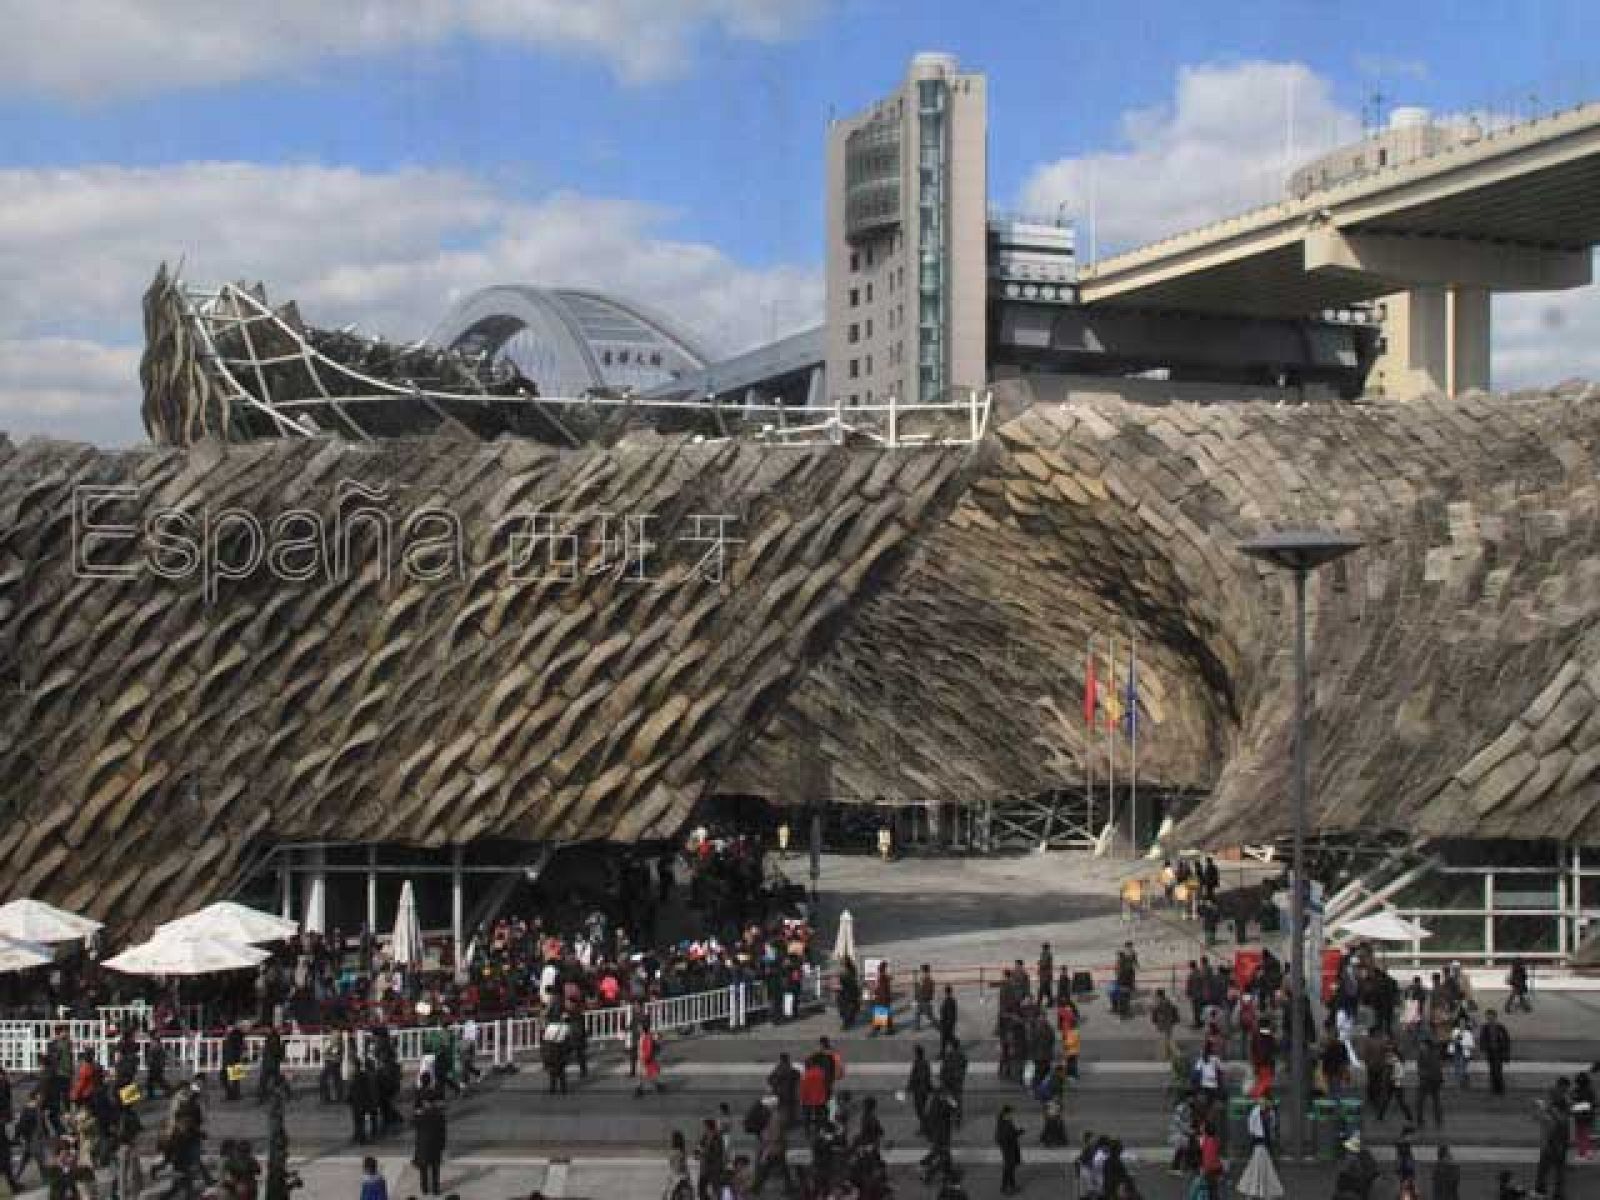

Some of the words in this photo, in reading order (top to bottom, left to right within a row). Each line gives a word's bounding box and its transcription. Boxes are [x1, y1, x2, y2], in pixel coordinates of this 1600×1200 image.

[72, 479, 465, 603] España
[506, 511, 746, 584] 西班牙
